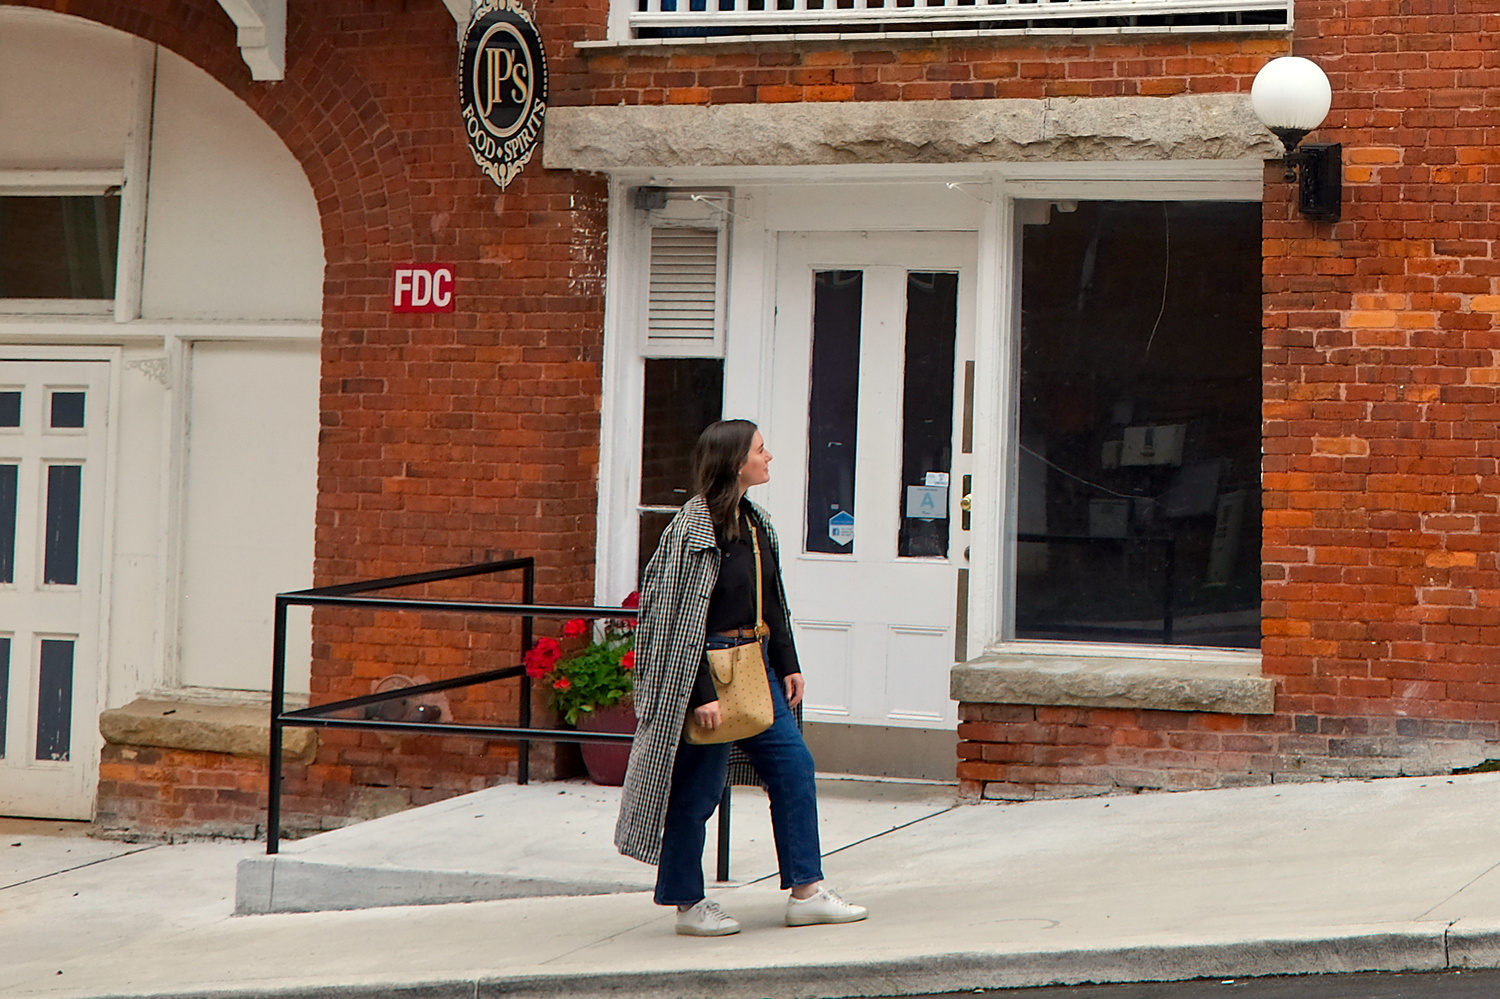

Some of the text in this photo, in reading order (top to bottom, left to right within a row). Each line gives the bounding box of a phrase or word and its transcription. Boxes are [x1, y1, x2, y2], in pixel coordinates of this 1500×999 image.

[462, 97, 547, 163] FOOD SPIRITS
[394, 268, 452, 308] FDC
[920, 491, 935, 509] A
